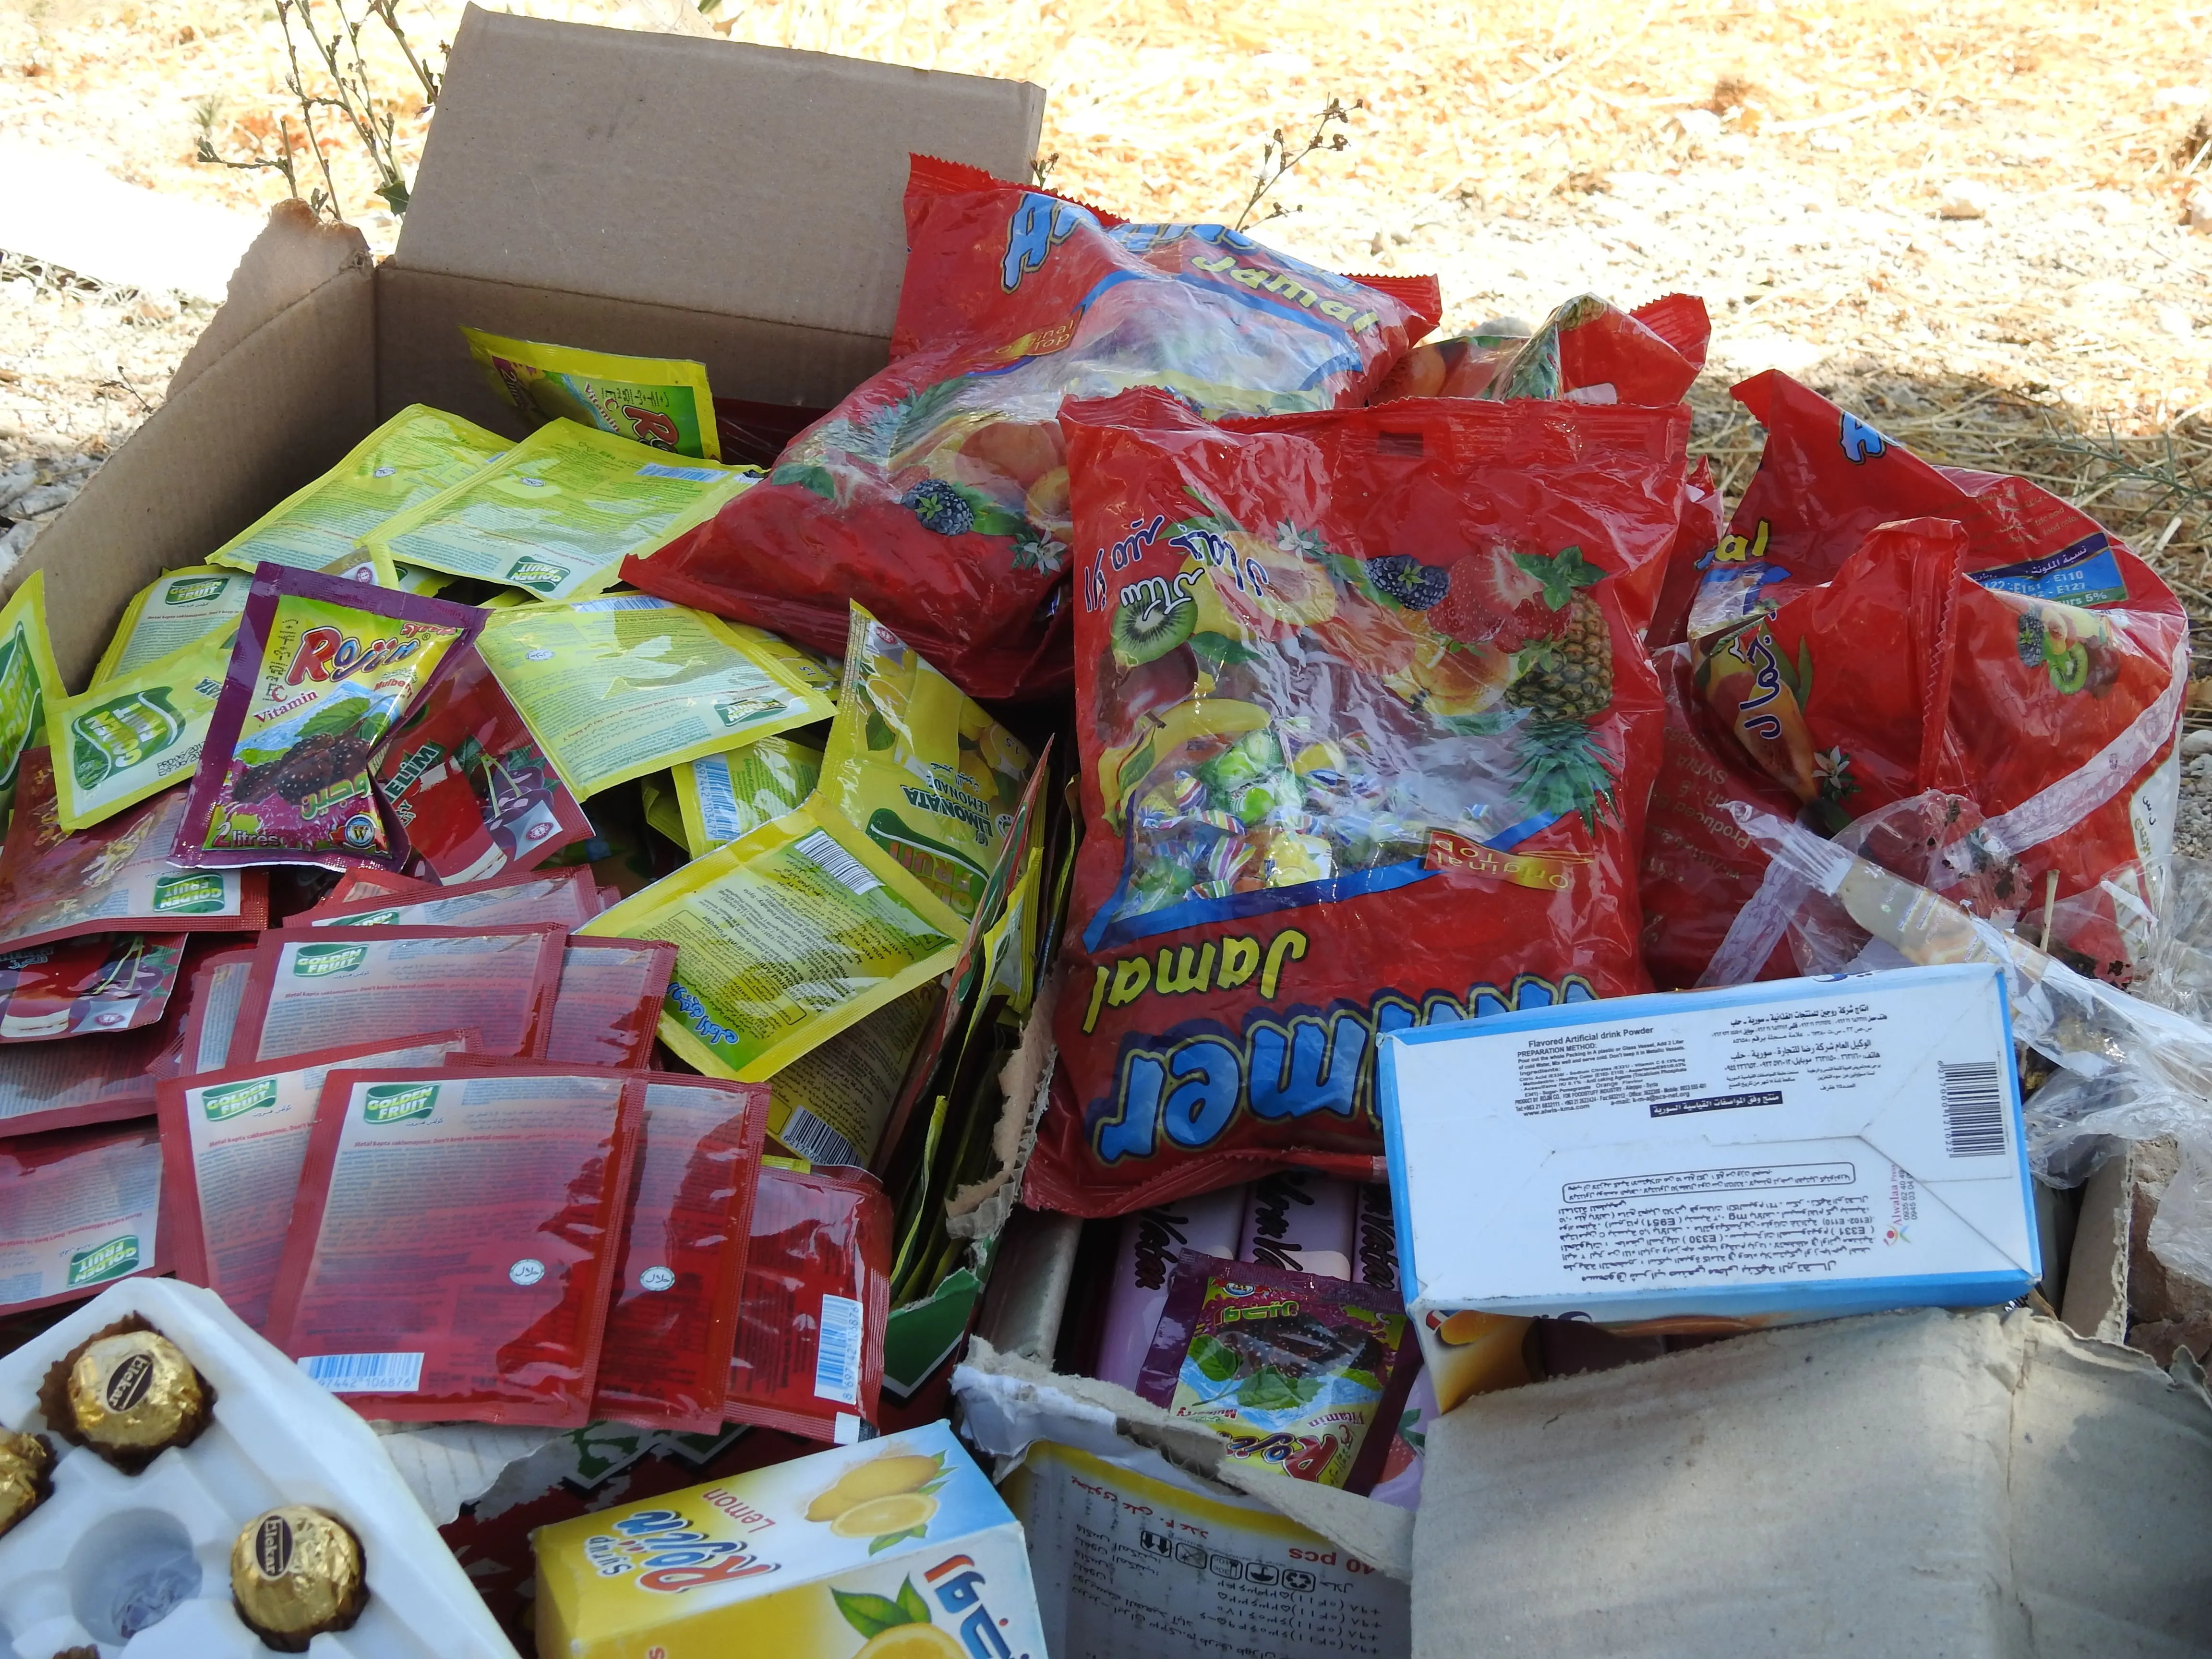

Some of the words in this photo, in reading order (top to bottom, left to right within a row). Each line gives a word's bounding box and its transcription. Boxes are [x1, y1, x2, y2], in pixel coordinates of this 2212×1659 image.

[1190, 254, 1379, 335] Jamal
[584, 381, 621, 433] Vitamin
[1168, 524, 1270, 599] جمال
[2059, 543, 2088, 564] نسبة
[510, 568, 562, 583] GOLDEN
[518, 561, 561, 576] FRUIT
[2052, 567, 2084, 586] E110
[170, 578, 228, 599] GOLDEN
[177, 586, 219, 601] FRUIT
[1119, 566, 1206, 622] سكاكر
[2055, 579, 2086, 596] E127
[2084, 590, 2107, 602] 5%
[285, 626, 421, 686] Rojin
[1739, 634, 1782, 741] جمال
[253, 690, 319, 723] Vitamin
[113, 701, 167, 743] FRUIT
[87, 710, 143, 768] GOLDEN
[1676, 753, 1728, 784] SYRIA
[301, 771, 371, 821] وجين
[213, 821, 230, 848] 2
[232, 830, 280, 847] litres
[1673, 802, 1751, 850] Produced
[1435, 839, 1500, 864] Top
[888, 842, 974, 891] FRUIT
[1437, 851, 1569, 889] Original
[160, 887, 221, 909] GOLDEN
[165, 877, 203, 898] FRUIT
[700, 914, 729, 940] Powder
[726, 935, 745, 953] drink
[297, 947, 368, 968] GOLDEN
[308, 957, 355, 974] FRUIT
[742, 948, 773, 977] Artificial
[770, 973, 802, 1003] Flavored
[1083, 929, 1310, 1034] Jamal
[1528, 1036, 1563, 1047] Flavored
[1564, 1032, 1598, 1044] Artificial
[1600, 1029, 1621, 1038] drink
[1623, 1026, 1654, 1036] Powder
[1815, 1041, 1835, 1054] شركة
[1835, 1041, 1850, 1052] العام
[1849, 1038, 1872, 1050] الوكيل
[1516, 1046, 1565, 1058] PREPARATION
[1565, 1043, 1597, 1052] METHOD:
[1565, 1050, 1586, 1058] Packing
[1730, 1050, 1746, 1062] حلب
[1750, 1047, 1772, 1060] سورية
[1776, 1044, 1800, 1058] للتجارة
[1519, 1066, 1561, 1077] Ingredients:
[206, 1081, 271, 1111] GOLDEN
[1595, 1081, 1619, 1089] Orange
[220, 1090, 268, 1115] FRUIT
[367, 1087, 432, 1111] GOLDEN
[378, 1098, 426, 1120] FRUIT
[1682, 1099, 1712, 1112] القياسية
[1713, 1095, 1746, 1108] المواصفات
[1746, 1094, 1761, 1105] وفق
[1761, 1092, 1779, 1104] منتج
[1652, 1103, 1682, 1116] السورية
[1728, 1211, 1747, 1221] mg
[1889, 1185, 1902, 1226] Alwalaa
[1646, 1217, 1675, 1227] E951
[1559, 1239, 1602, 1250] المحتويات
[1688, 1234, 1716, 1243] E330
[1838, 1226, 1865, 1235] E331
[75, 1245, 137, 1284] GOLDEN
[79, 1241, 126, 1273] FRUIT
[514, 1266, 540, 1279] حلال
[645, 1273, 672, 1285] حلال
[1580, 1270, 1627, 1285] مسحوق
[1629, 1268, 1666, 1282] شراب
[1668, 1264, 1705, 1279] صنعي
[1708, 1265, 1738, 1277] محلى
[1742, 1263, 1776, 1276] بنكهة
[1778, 1259, 1837, 1274] البرتقال
[1214, 1300, 1300, 1325] روجين
[1308, 1411, 1365, 1429] Vitamin
[701, 1487, 777, 1535] Lemon
[1120, 1500, 1155, 1518] على
[1178, 1522, 1210, 1539] عدد
[612, 1509, 781, 1593] Rojin
[1286, 1542, 1337, 1566] pcs
[1317, 1576, 1354, 1596] حلال
